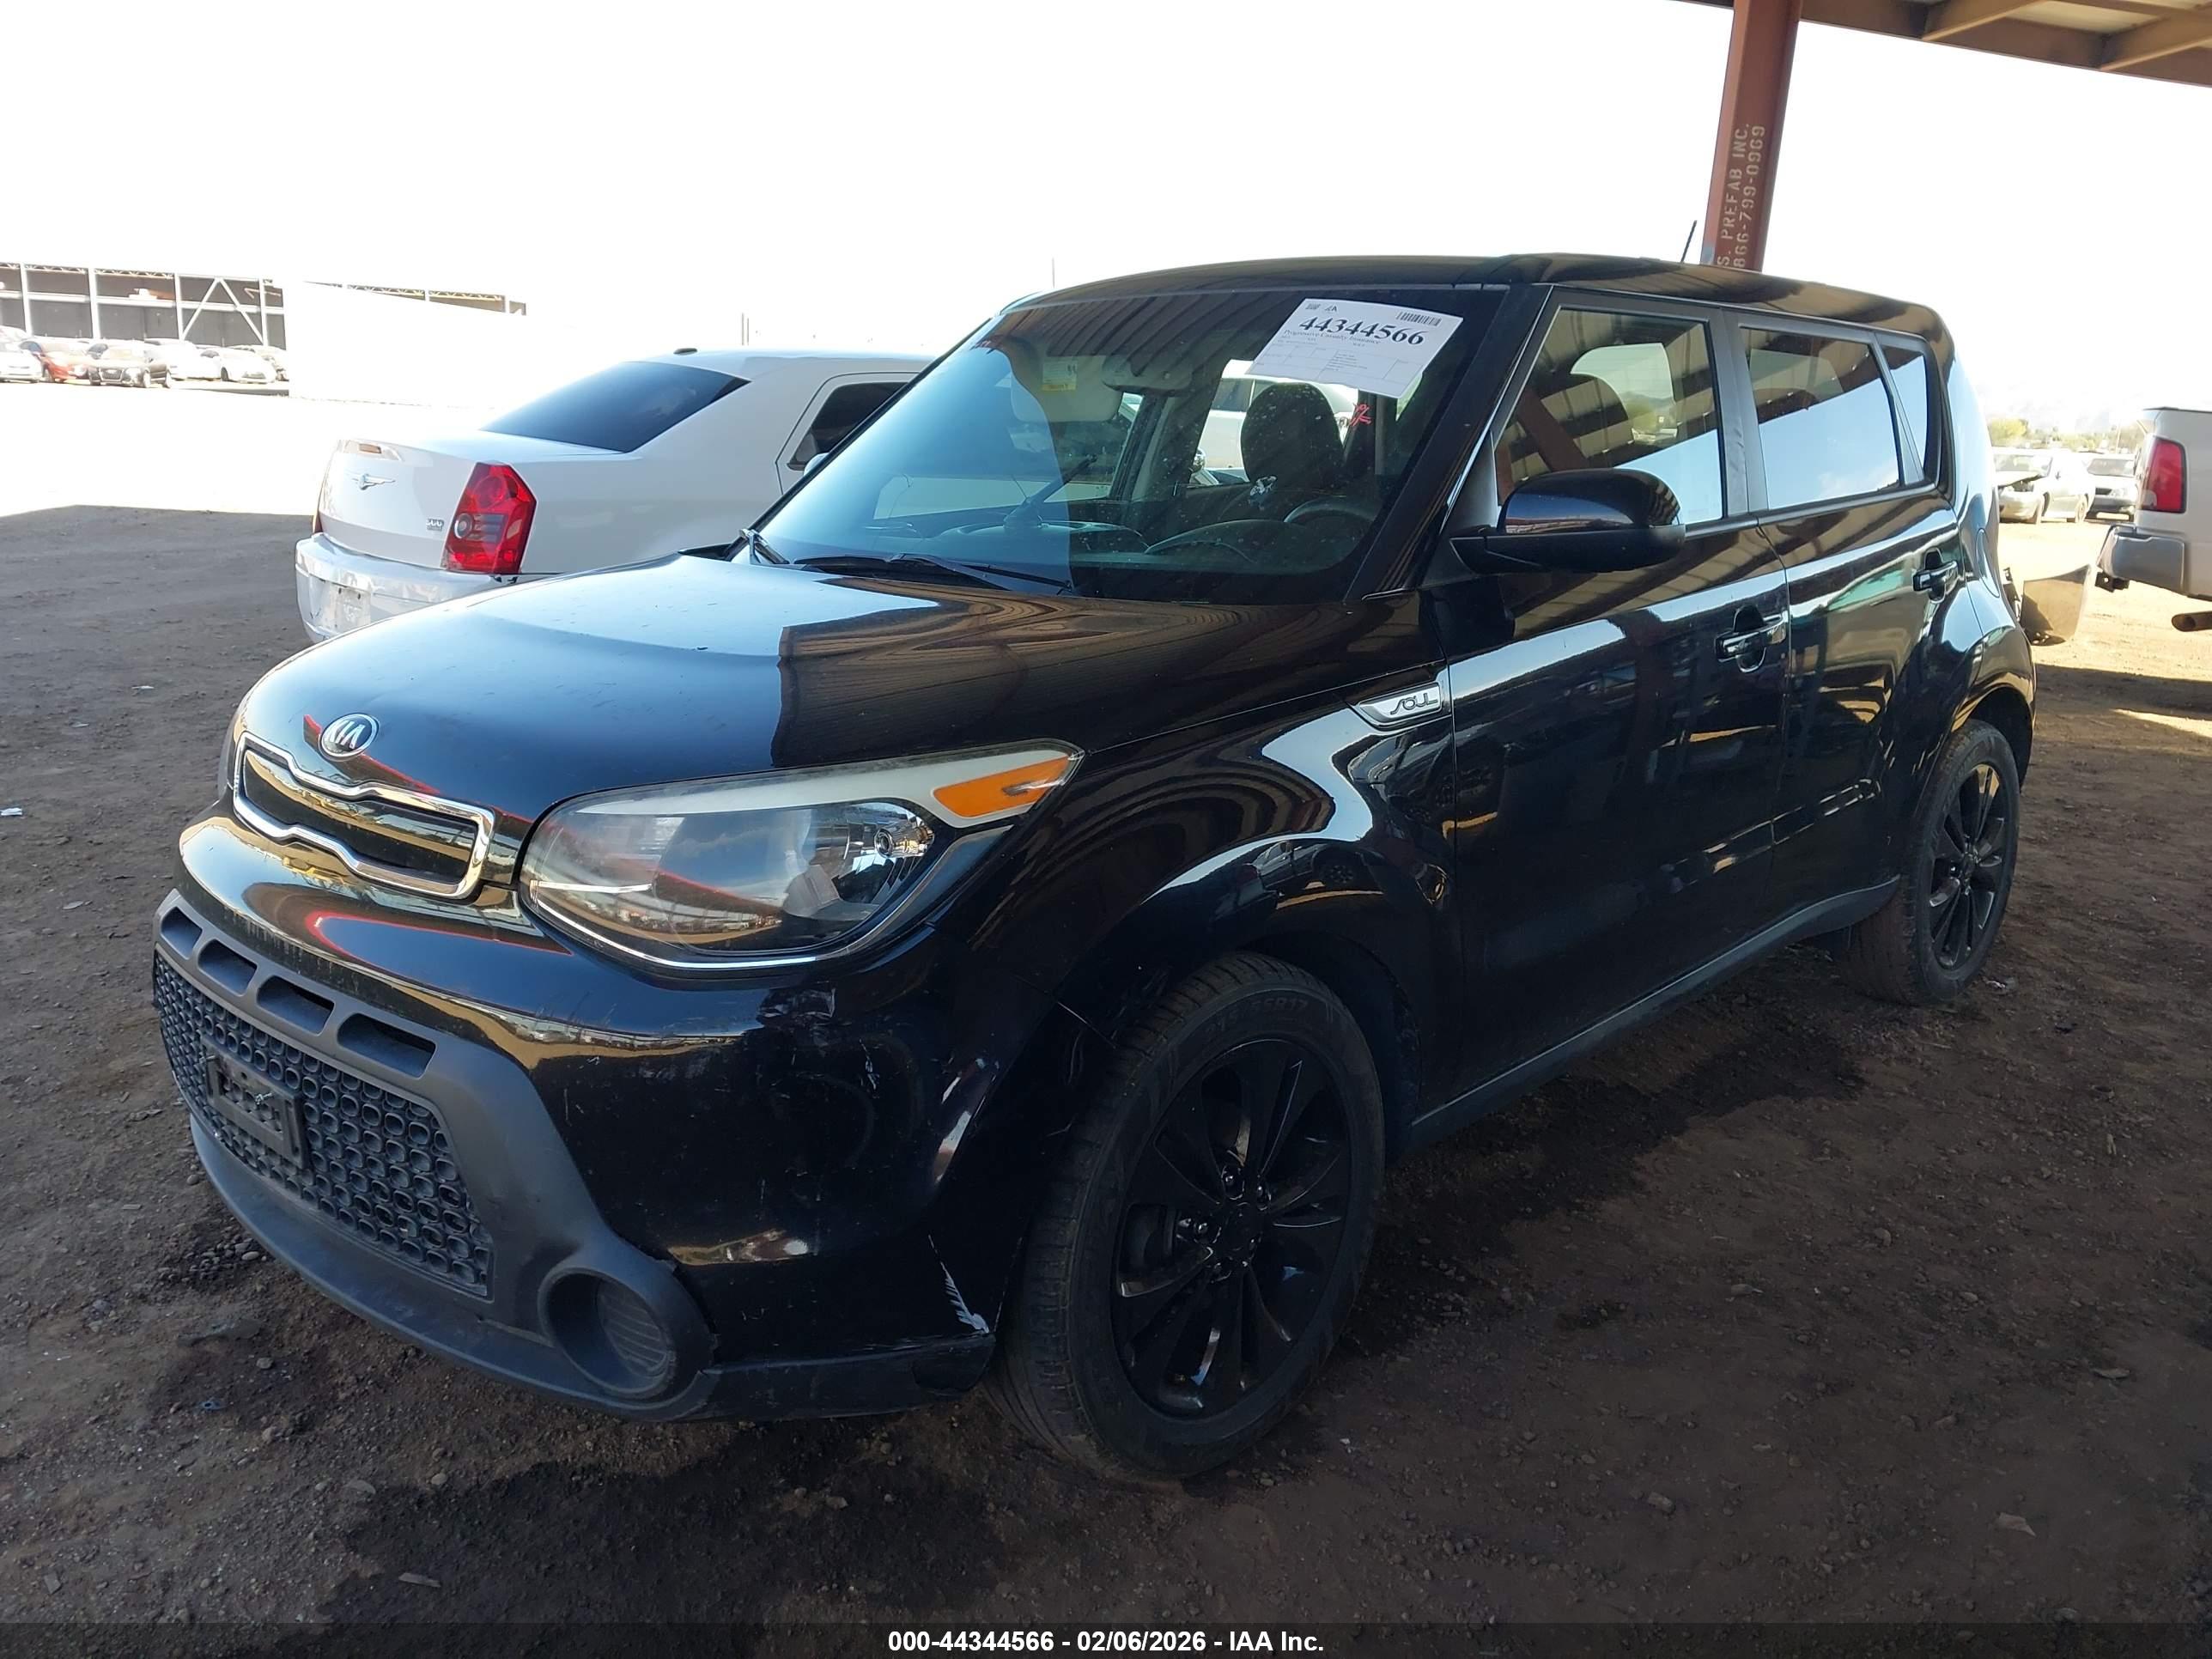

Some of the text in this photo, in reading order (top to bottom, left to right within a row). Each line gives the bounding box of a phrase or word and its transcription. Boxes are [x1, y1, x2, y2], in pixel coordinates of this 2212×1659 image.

[1721, 167, 1743, 240] PREFAB
[1732, 124, 1750, 158] INC.
[1733, 125, 1765, 268] 866-799-0969
[1299, 316, 1430, 345] 44344566
[1389, 692, 1438, 715] SOUL
